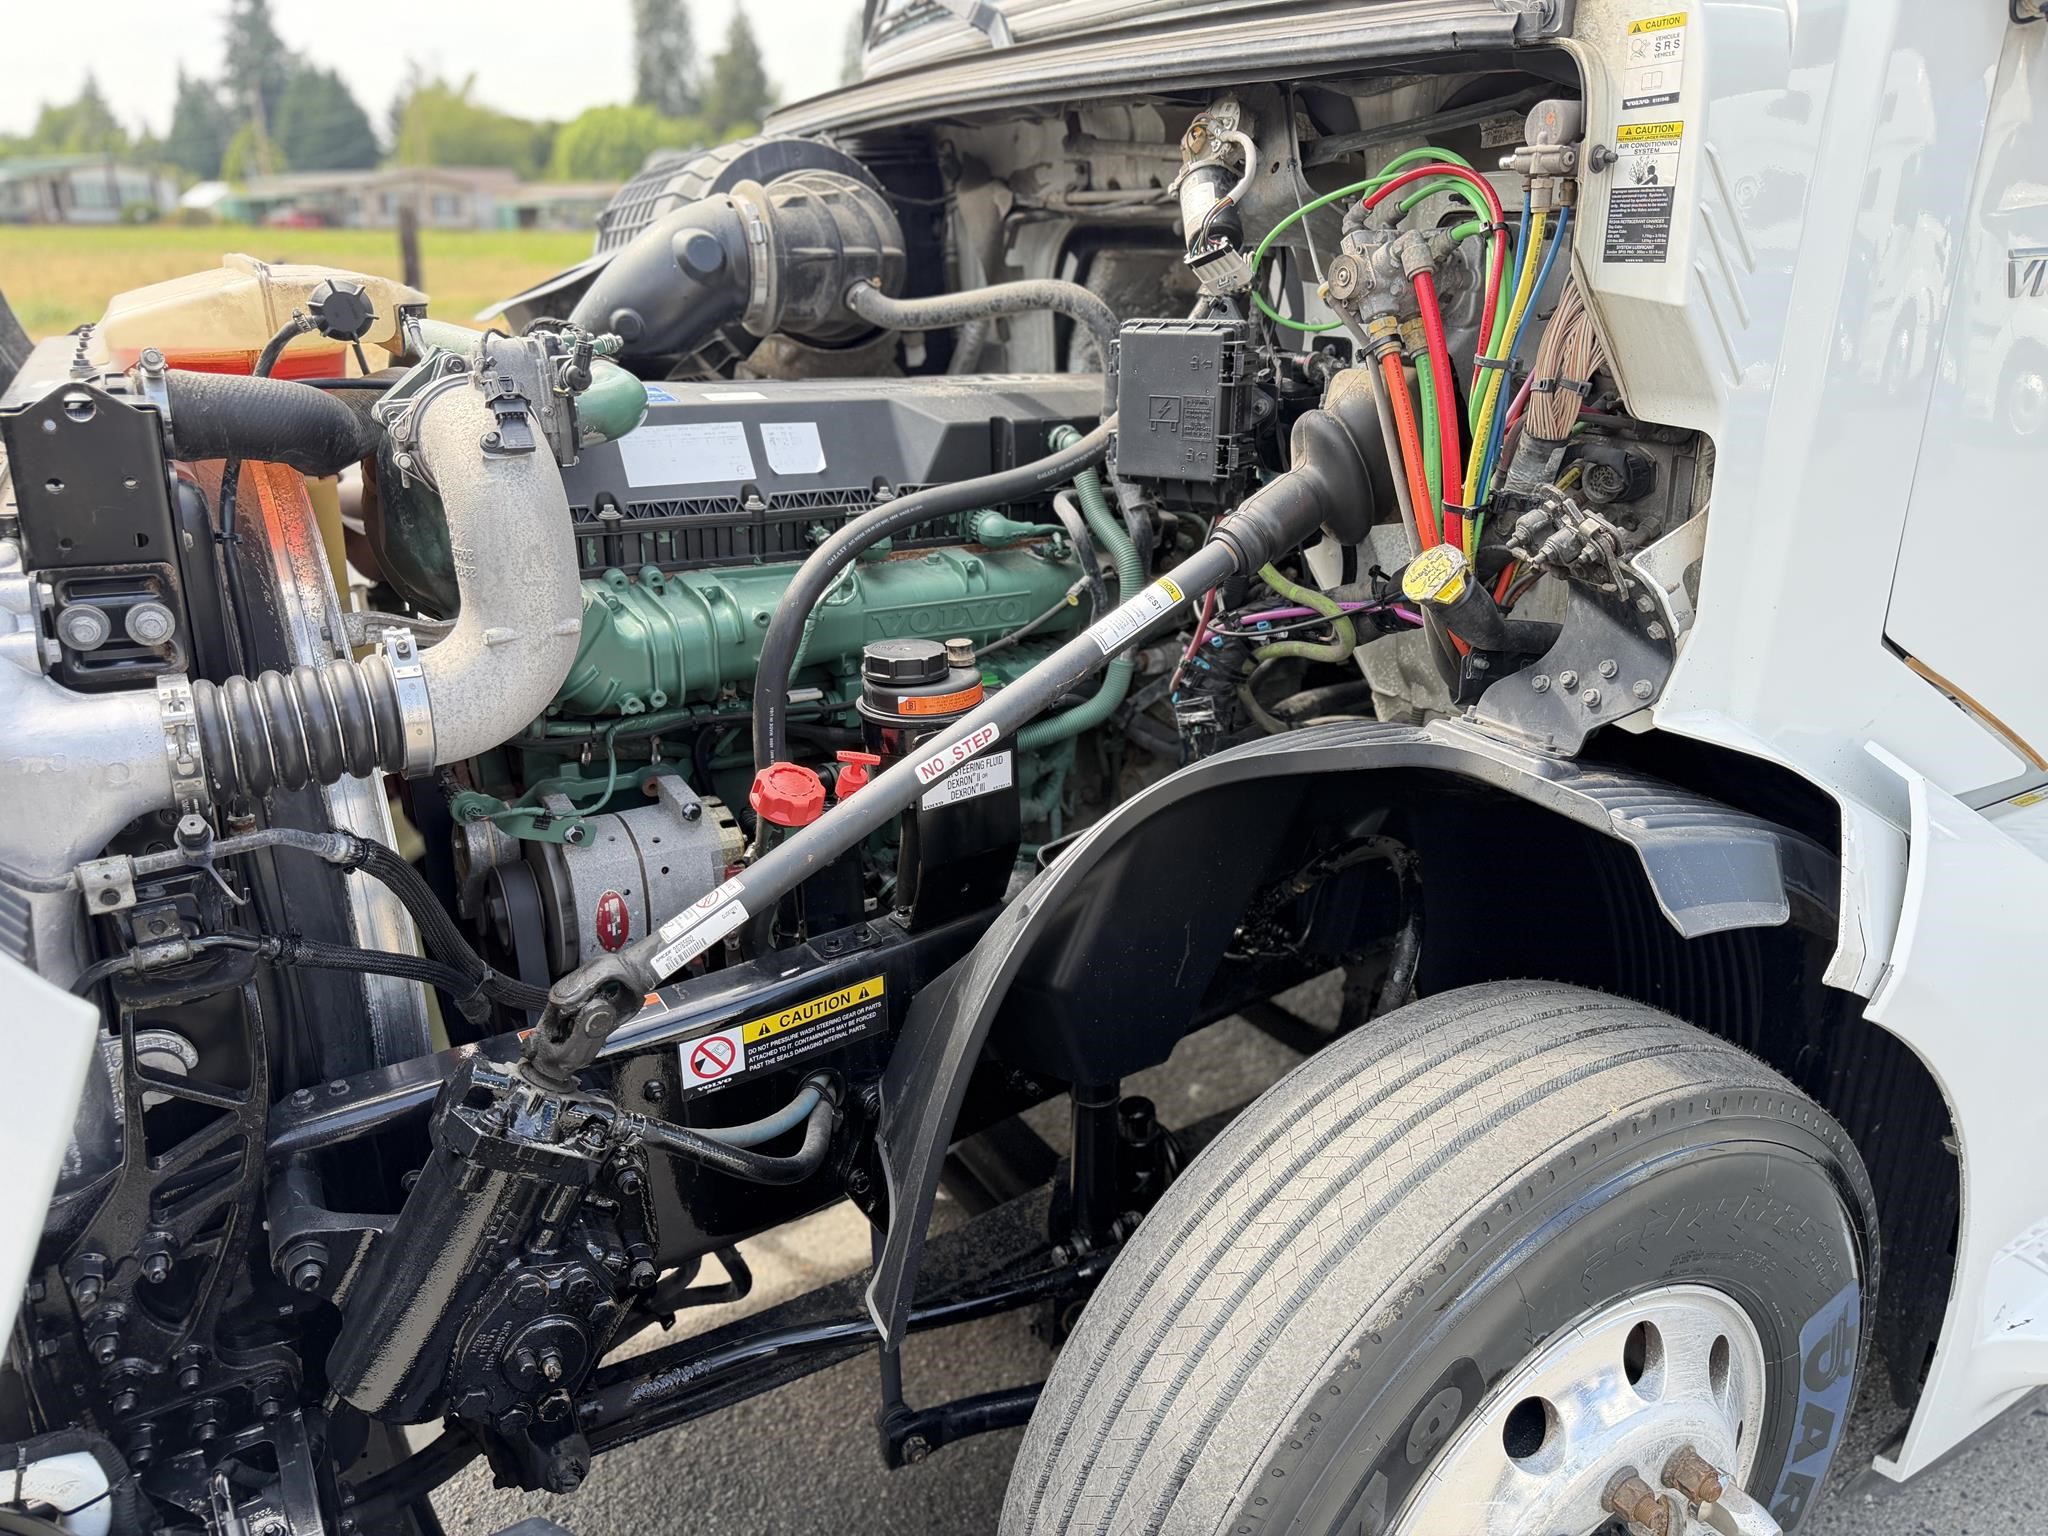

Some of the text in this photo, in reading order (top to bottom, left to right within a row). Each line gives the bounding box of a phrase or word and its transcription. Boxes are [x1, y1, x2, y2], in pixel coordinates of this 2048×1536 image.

[1646, 16, 1680, 29] CAUTION
[1656, 32, 1680, 41] VEHICULE
[1636, 124, 1674, 134] CAUTION
[827, 546, 848, 566] GALAXY
[872, 601, 1024, 638] VOLVO
[921, 728, 992, 779] NO STEP
[954, 762, 984, 776] STEERING
[986, 756, 1003, 767] FLUID
[780, 992, 850, 1027] CAUTION
[749, 1049, 778, 1063] ATTACHED
[795, 1028, 835, 1046] CONTAMINANTS
[836, 1021, 848, 1030] MAY
[856, 1012, 876, 1024] FORCED
[758, 1043, 769, 1051] NOT
[770, 1032, 799, 1047] PRESSURE
[800, 1027, 815, 1036] WASH
[817, 1017, 841, 1030] STEERING
[842, 1011, 856, 1020] GEAR
[865, 1002, 882, 1012] PARTS
[749, 1024, 866, 1071] PAST THE SEALS DAMAGING INTERNAL PARTS.
[697, 1078, 732, 1092] VOLVO
